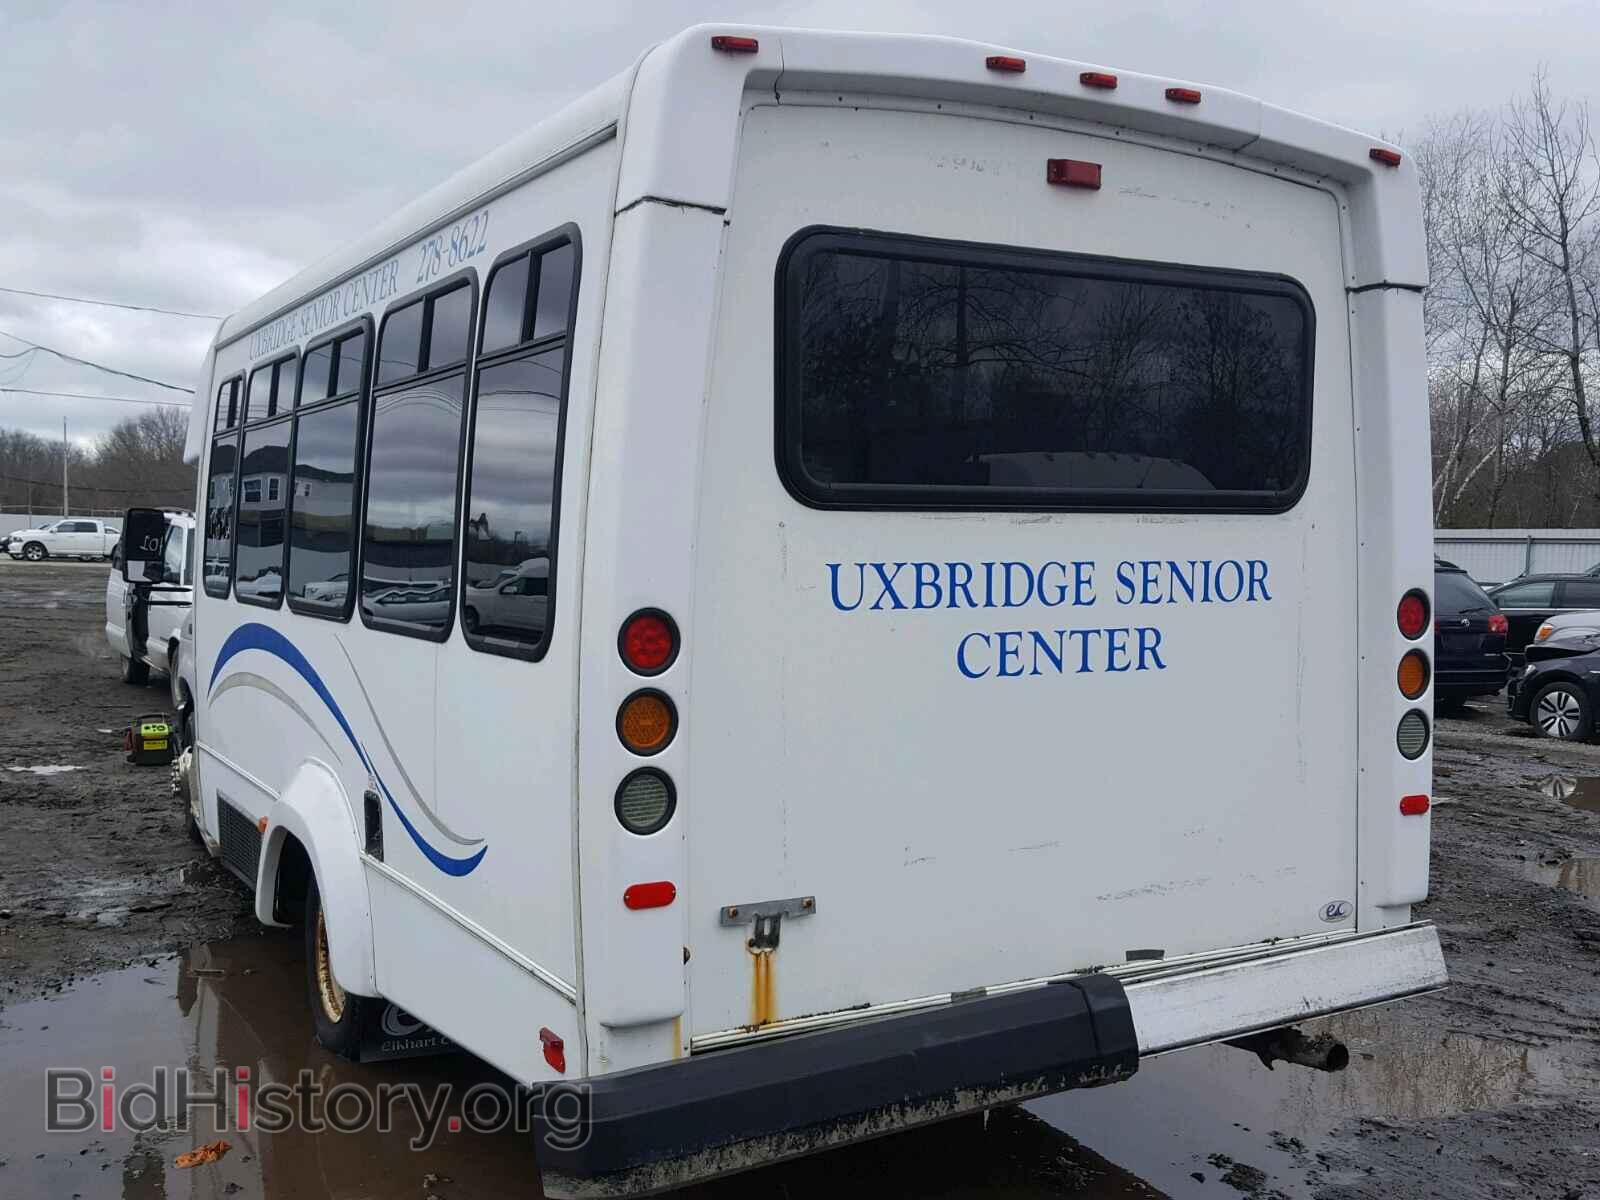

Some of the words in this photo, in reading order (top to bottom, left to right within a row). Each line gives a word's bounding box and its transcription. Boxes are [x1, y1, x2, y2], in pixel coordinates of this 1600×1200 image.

[249, 312, 297, 361] UXBRIDGE
[299, 288, 339, 337] SENIOR
[343, 259, 400, 318] CENTER
[416, 210, 489, 284] 278-8622
[825, 560, 1097, 611] UXBRIDGE
[1114, 559, 1273, 606] SENIOR
[956, 627, 1167, 679] CENTER
